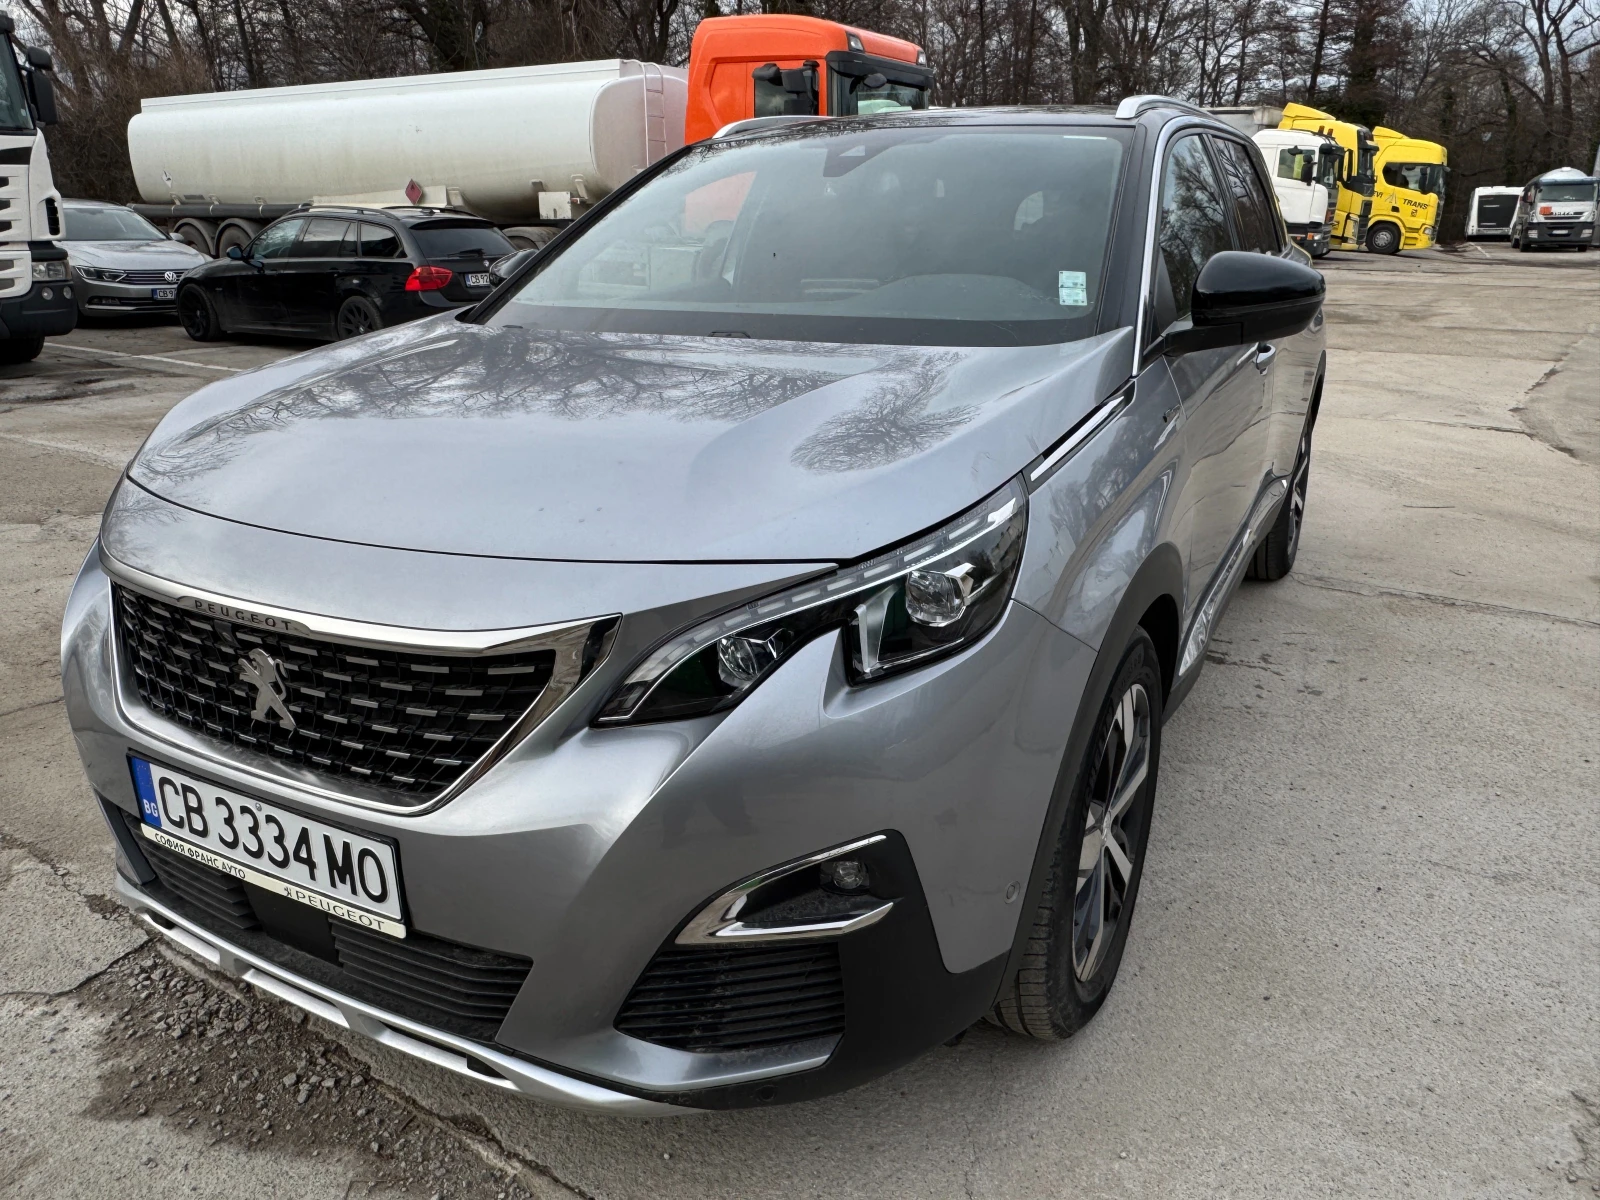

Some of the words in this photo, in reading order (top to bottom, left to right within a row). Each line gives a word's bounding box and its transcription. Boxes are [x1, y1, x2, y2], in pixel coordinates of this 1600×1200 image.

[1403, 198, 1428, 210] TRANS
[195, 599, 292, 631] PEUGEOT
[143, 798, 159, 818] BG
[158, 776, 209, 839] CB
[215, 796, 317, 881] 3334
[154, 832, 186, 854] СОФИЯ
[187, 847, 220, 870] ФРАНС
[221, 864, 246, 880] АУТО
[295, 891, 385, 931] PEUGEOT
